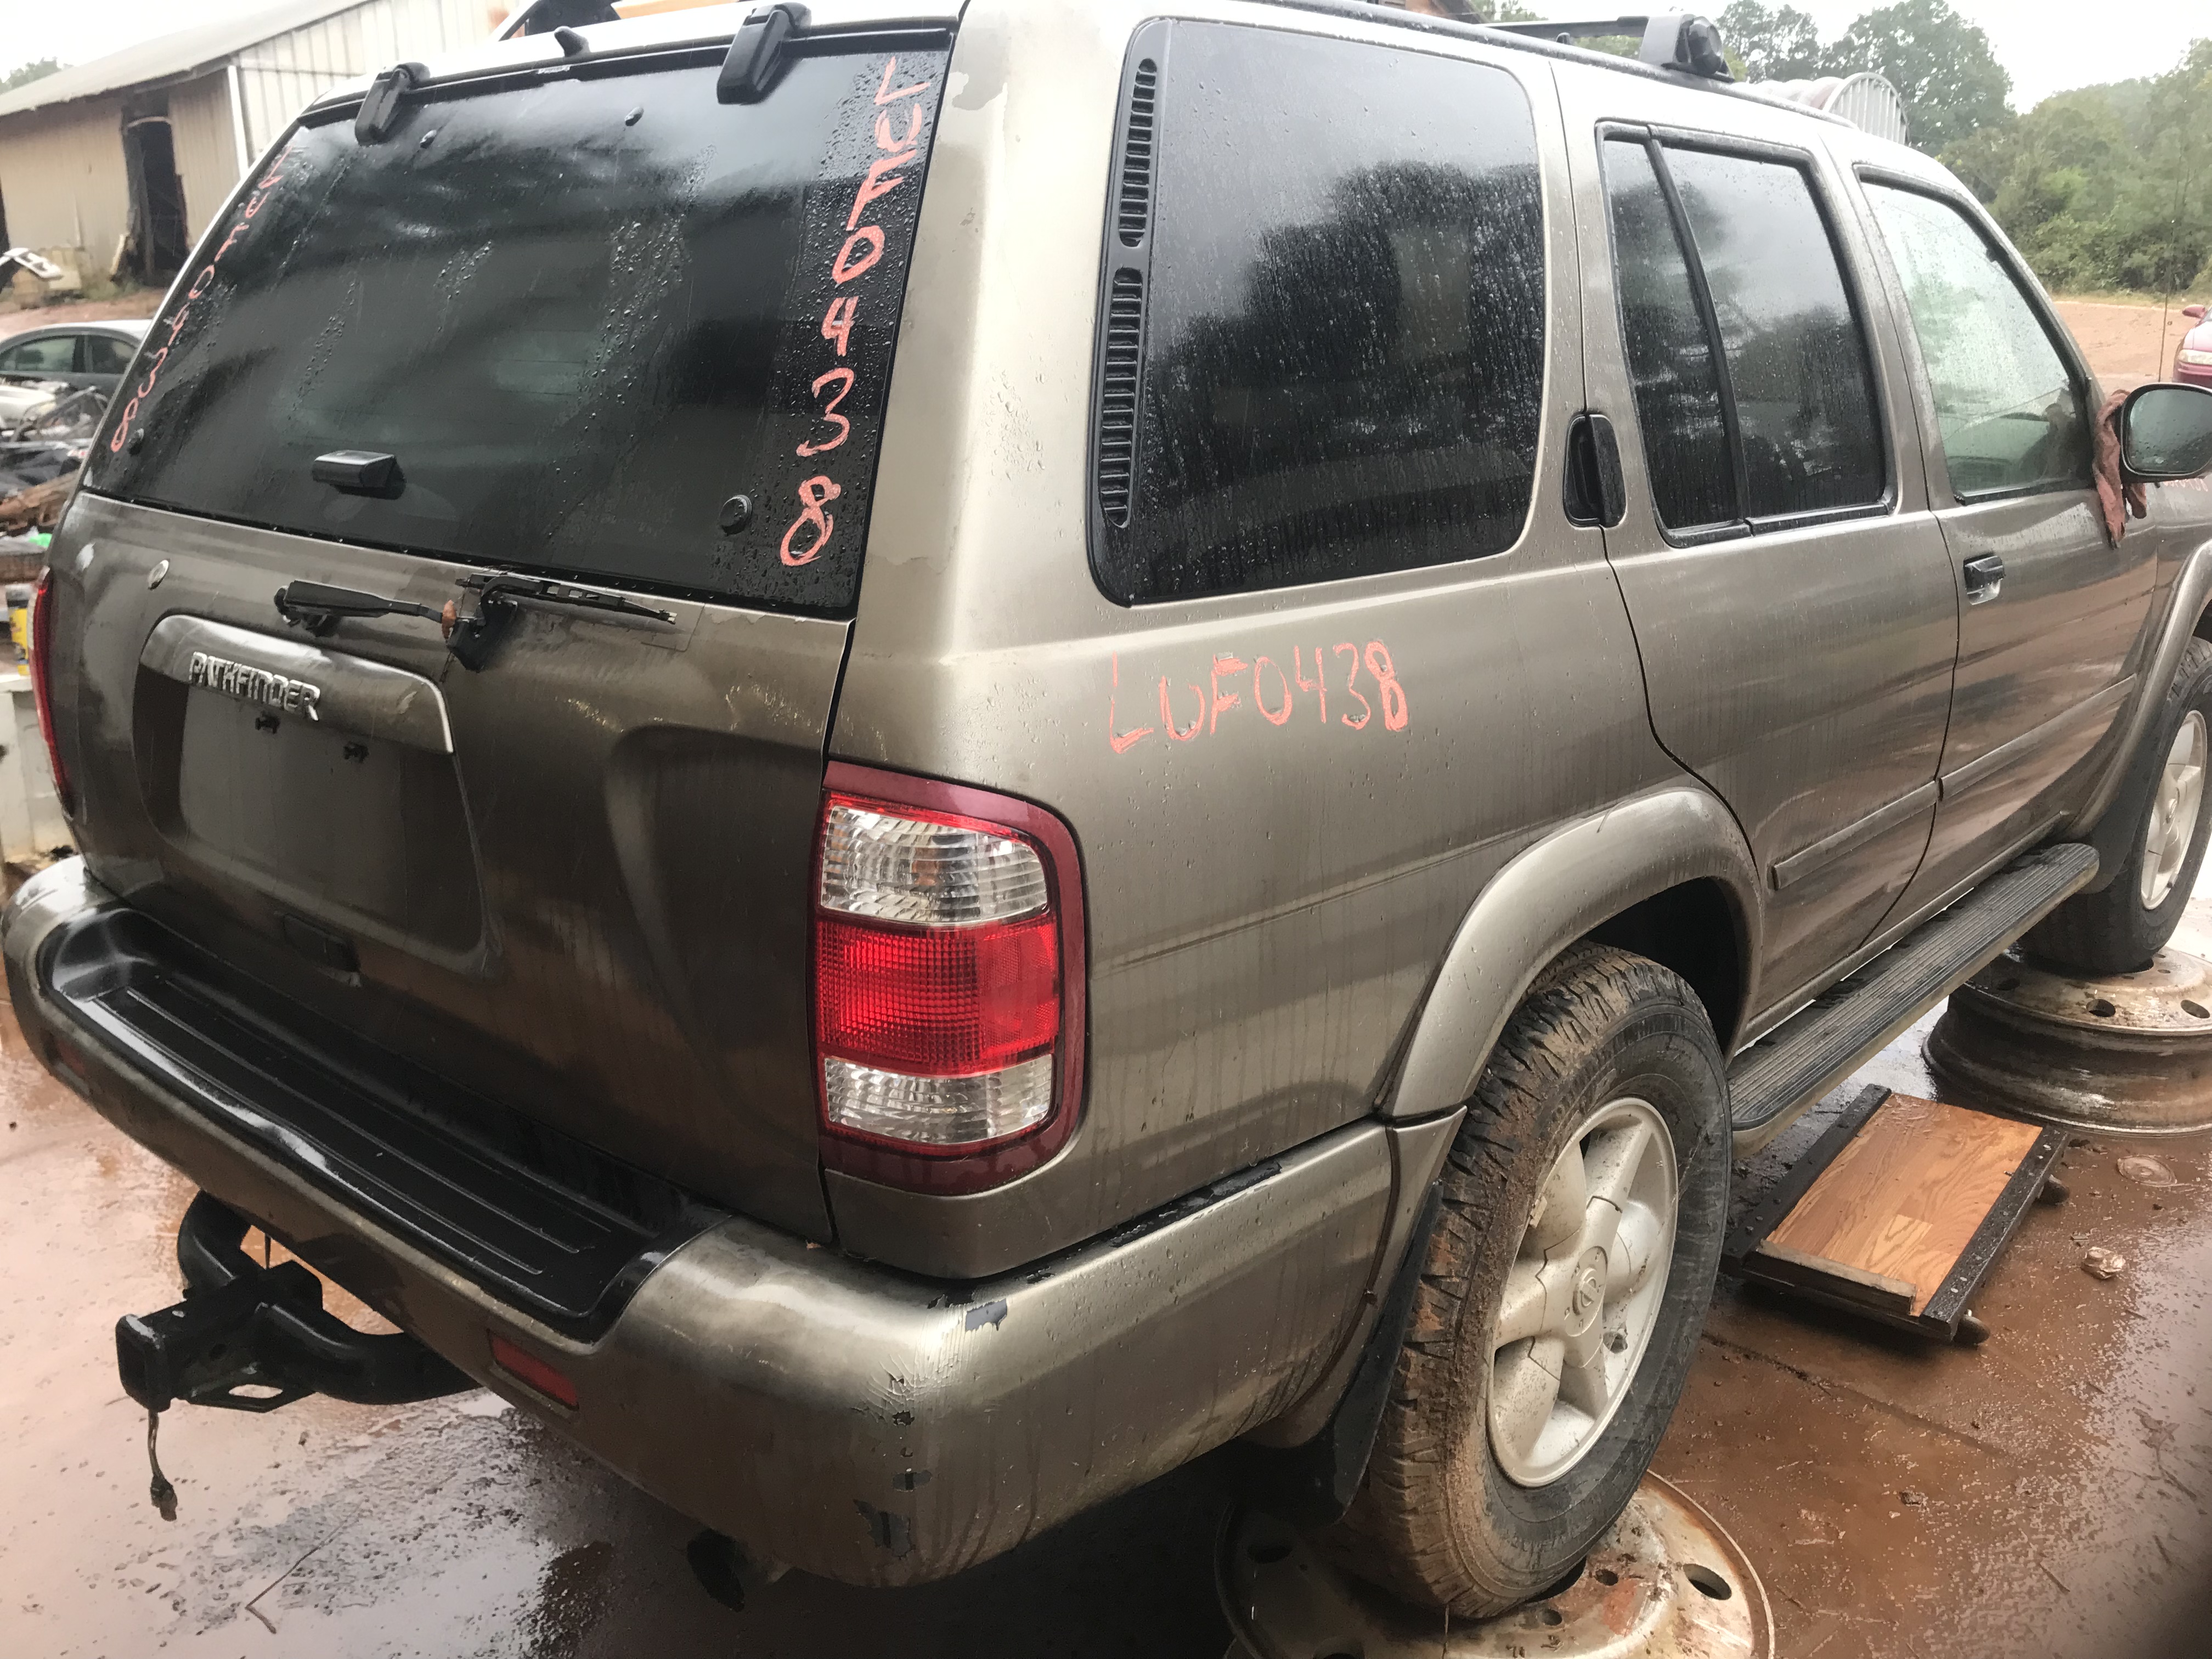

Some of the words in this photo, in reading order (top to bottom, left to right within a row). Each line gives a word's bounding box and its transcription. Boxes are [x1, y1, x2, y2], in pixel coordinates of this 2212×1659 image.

[779, 55, 931, 566] LUF0438
[189, 651, 320, 721] PATHFINDER
[1109, 639, 1408, 754] LUF0438
